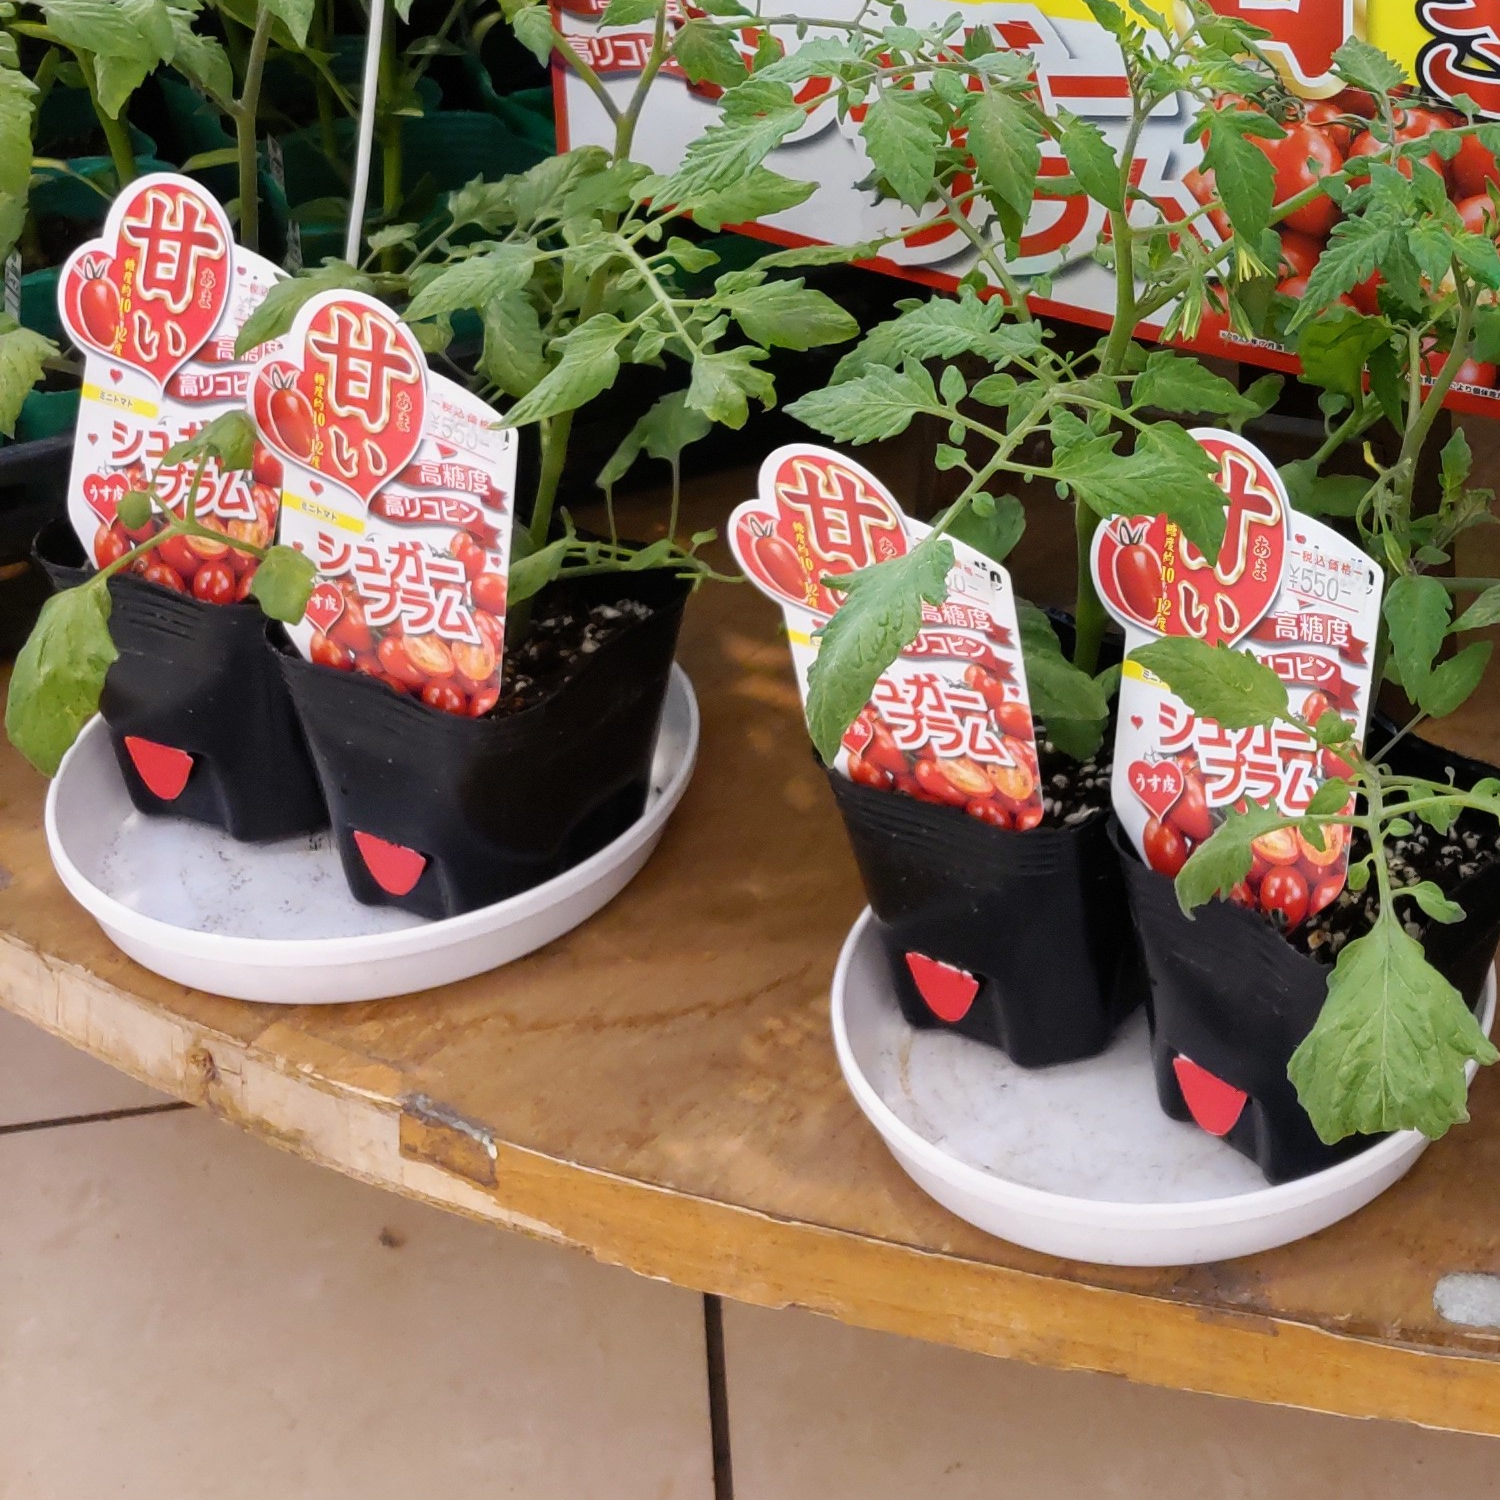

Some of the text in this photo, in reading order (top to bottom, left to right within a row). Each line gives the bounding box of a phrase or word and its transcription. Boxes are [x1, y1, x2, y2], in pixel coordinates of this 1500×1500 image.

[121, 190, 227, 362] 甘い
[199, 266, 217, 309] あま
[99, 391, 134, 407] ミニトマト
[180, 373, 249, 397] 高リコピ
[307, 305, 420, 477] 甘い
[395, 390, 413, 433] あま
[439, 401, 491, 428] 税込価格
[154, 464, 254, 514] プラム
[420, 459, 490, 495] 高糖度
[301, 501, 338, 522] ミニトマト
[384, 493, 480, 524] 高リコピン
[317, 530, 466, 583] シュガー
[1253, 534, 1271, 582] あま
[1302, 552, 1353, 576] 税込価格
[360, 575, 482, 644] プラム
[921, 601, 994, 632] 高糖度
[1275, 611, 1351, 648] 高糖度
[1257, 654, 1337, 682] リコピン
[874, 672, 987, 714] ュガー
[884, 708, 1018, 767] プラム
[1136, 772, 1178, 795] うす皮
[1205, 755, 1319, 810] プラム
